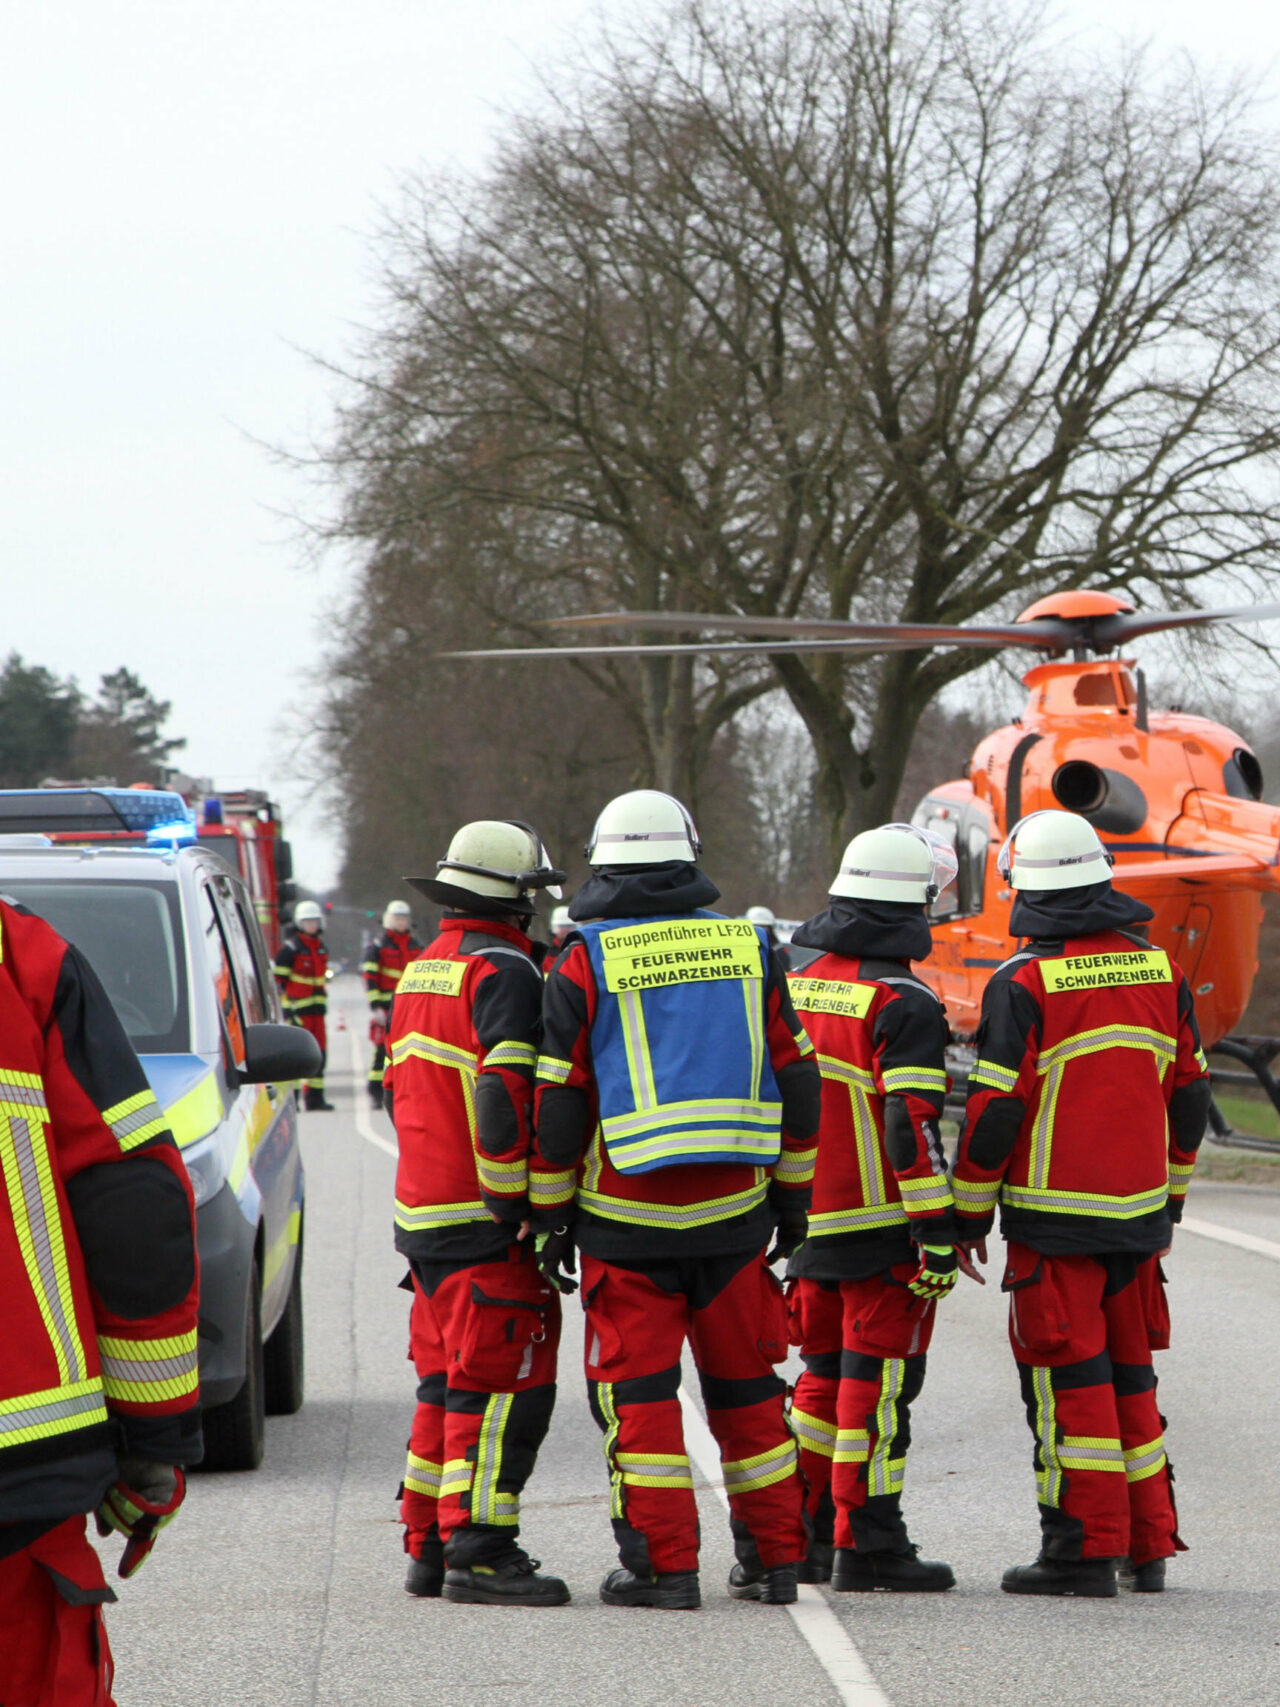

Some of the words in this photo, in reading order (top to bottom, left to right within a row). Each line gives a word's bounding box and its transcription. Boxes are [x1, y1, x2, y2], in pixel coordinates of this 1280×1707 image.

[604, 926, 713, 951] Gruppenführer
[716, 924, 753, 937] LF20
[632, 948, 733, 969] FEUERWEHR
[1065, 953, 1148, 970] FEUERWEHR
[617, 964, 753, 989] SCHWARZENBEK
[1055, 969, 1166, 989] SCHWARZENBEK
[791, 996, 859, 1015] HWARZENBEK
